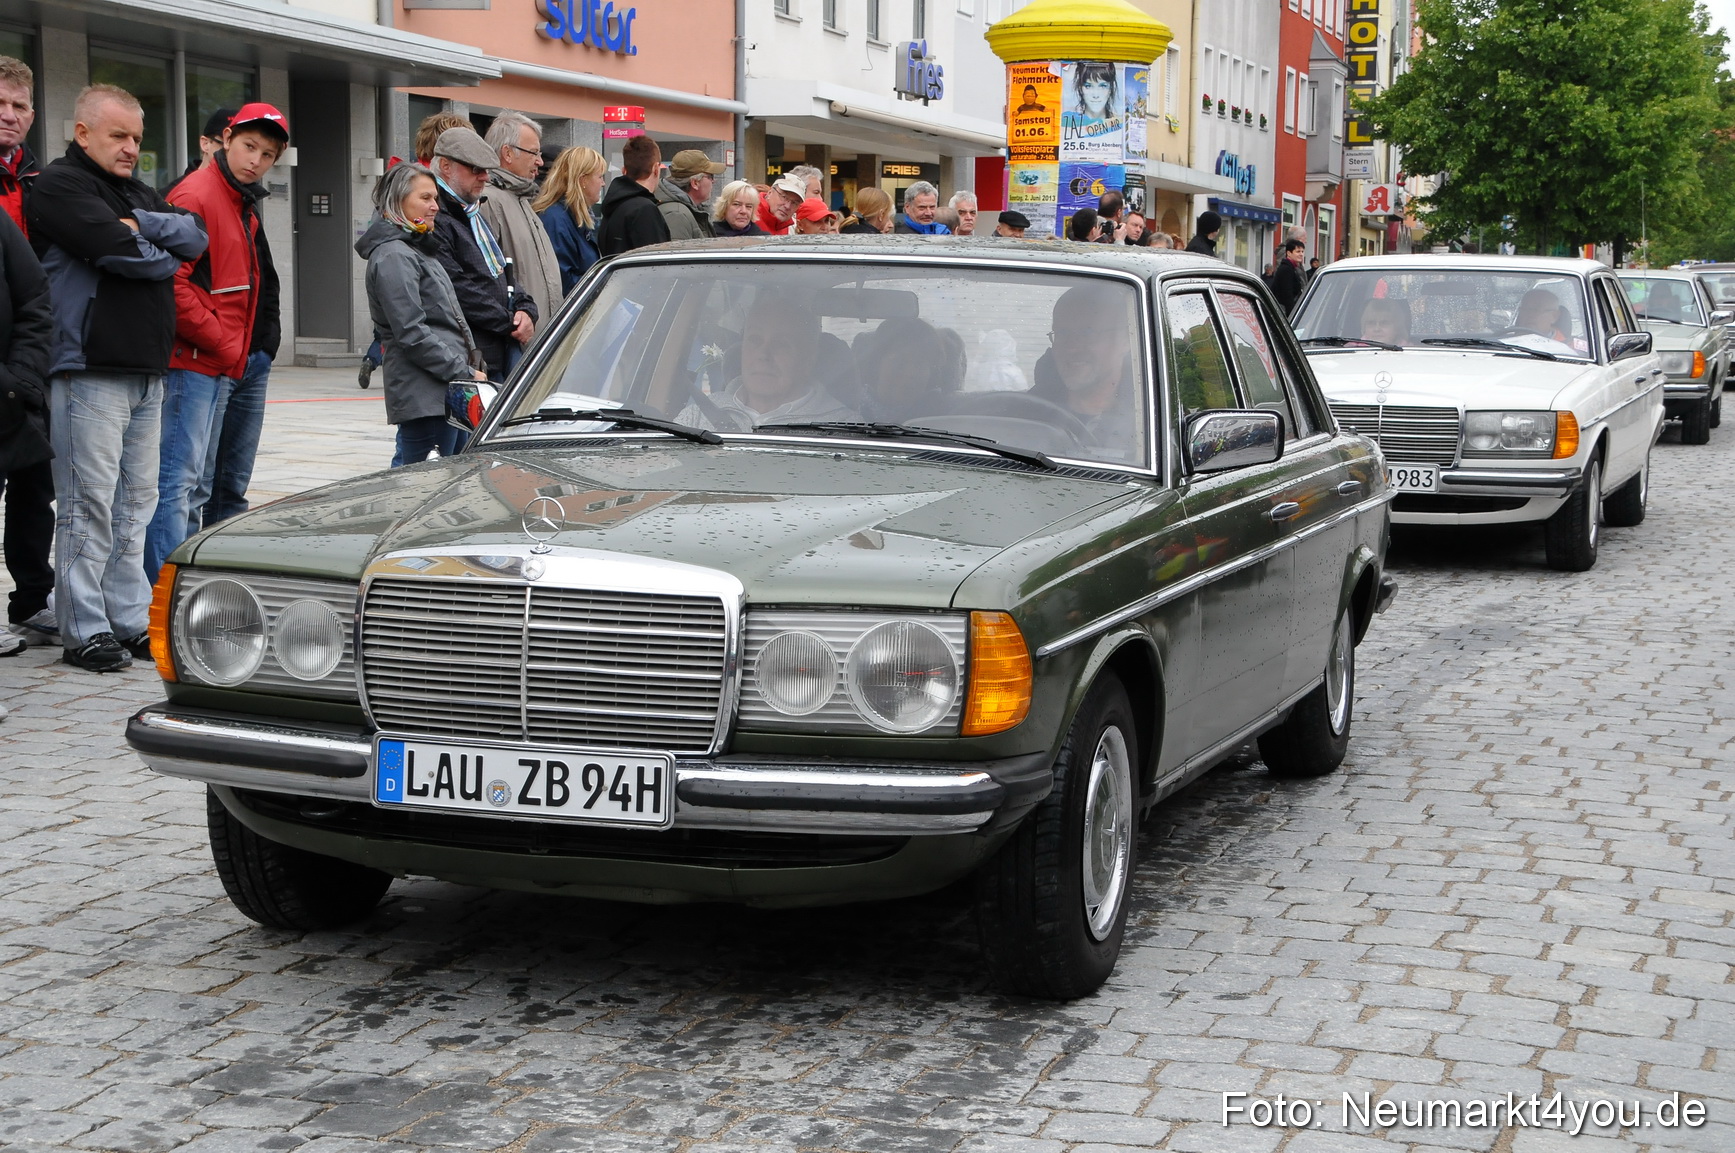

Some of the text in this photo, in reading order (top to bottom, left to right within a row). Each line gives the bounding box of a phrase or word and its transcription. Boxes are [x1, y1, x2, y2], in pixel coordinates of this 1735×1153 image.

[1012, 76, 1059, 84] Flohmarkt
[1014, 116, 1051, 126] Samstag
[1015, 127, 1049, 137] 01.06.
[1063, 113, 1085, 141] ZAZ
[1087, 119, 1122, 137] OPEN AIR
[1010, 146, 1055, 154] Volksfestplatz
[1063, 141, 1089, 151] 25.6.
[883, 165, 921, 175] FRIES
[385, 778, 396, 792] D
[407, 750, 484, 801] LAU
[518, 758, 571, 808] ZB
[582, 763, 663, 814] 94H
